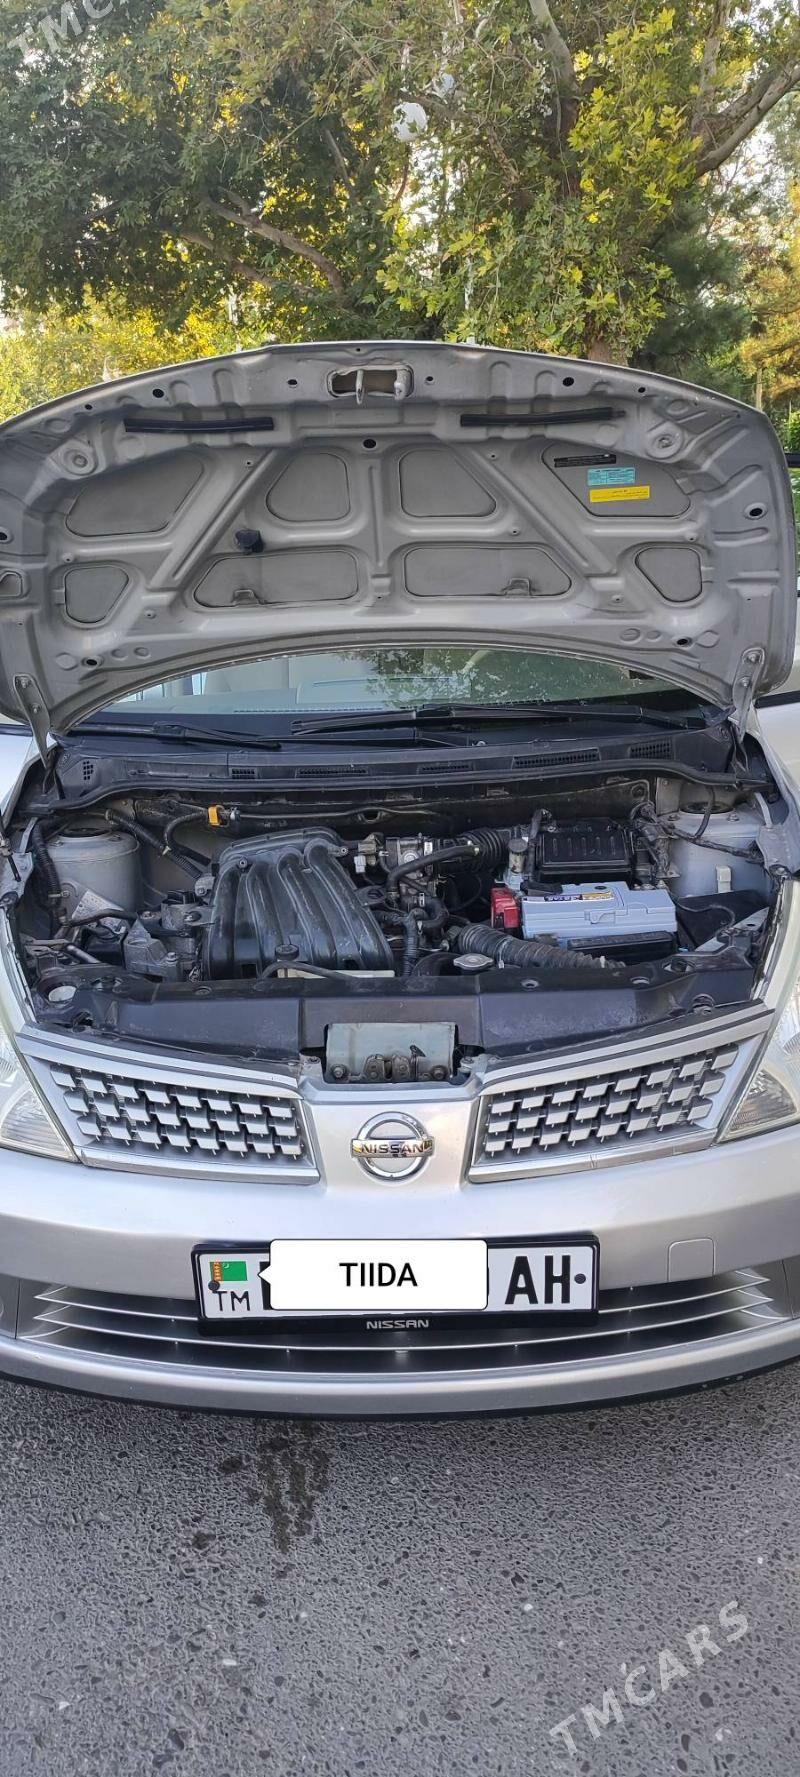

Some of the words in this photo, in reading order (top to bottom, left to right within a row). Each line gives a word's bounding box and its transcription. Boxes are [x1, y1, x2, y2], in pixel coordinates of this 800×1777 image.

[361, 1143, 424, 1154] NISSAN
[504, 1254, 572, 1305] AH
[216, 1290, 251, 1312] TM
[365, 1319, 430, 1330] NISSAN
